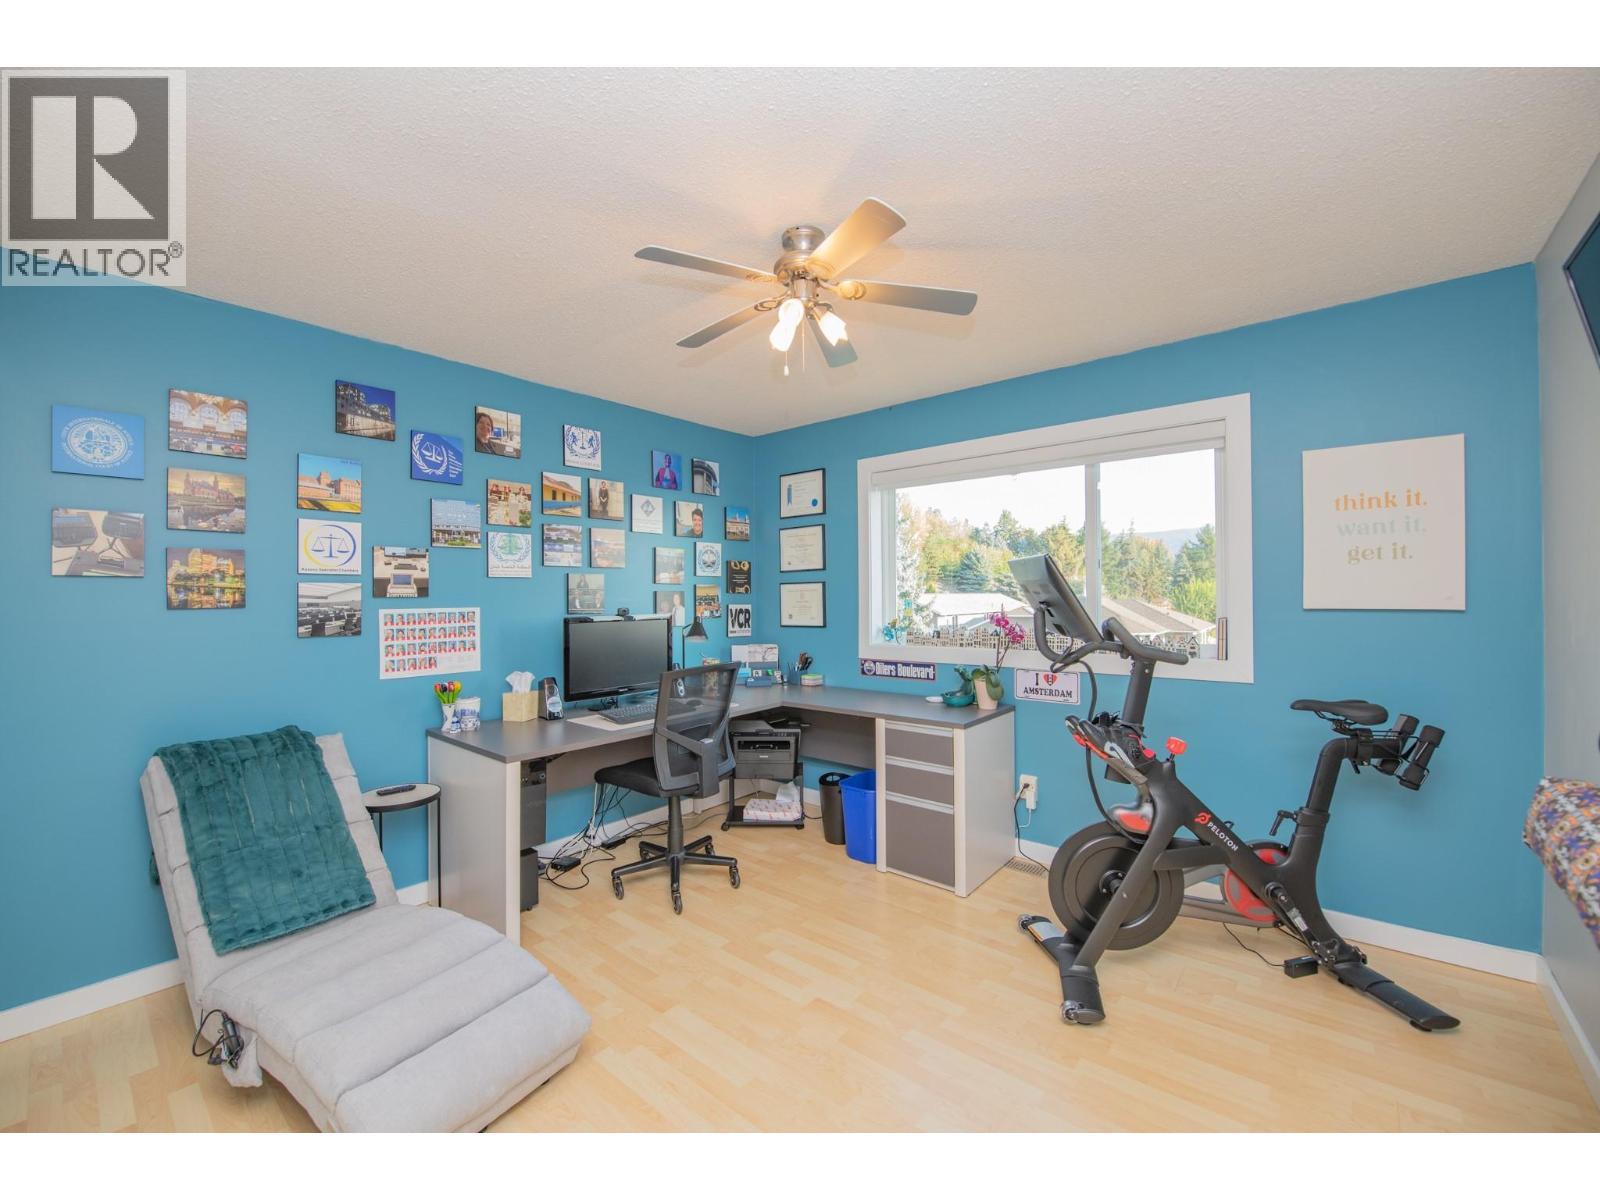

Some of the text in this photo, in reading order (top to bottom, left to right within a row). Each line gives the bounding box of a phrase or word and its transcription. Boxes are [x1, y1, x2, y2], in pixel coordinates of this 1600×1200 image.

[1334, 488, 1427, 511] think it.
[1337, 515, 1427, 536] want it.
[1348, 542, 1413, 565] get it.
[729, 608, 751, 629] VCR
[897, 663, 934, 680] Boulevard
[1035, 672, 1039, 686] I
[1023, 686, 1073, 698] AMSTERDAM
[1207, 821, 1239, 852] PELOTON
